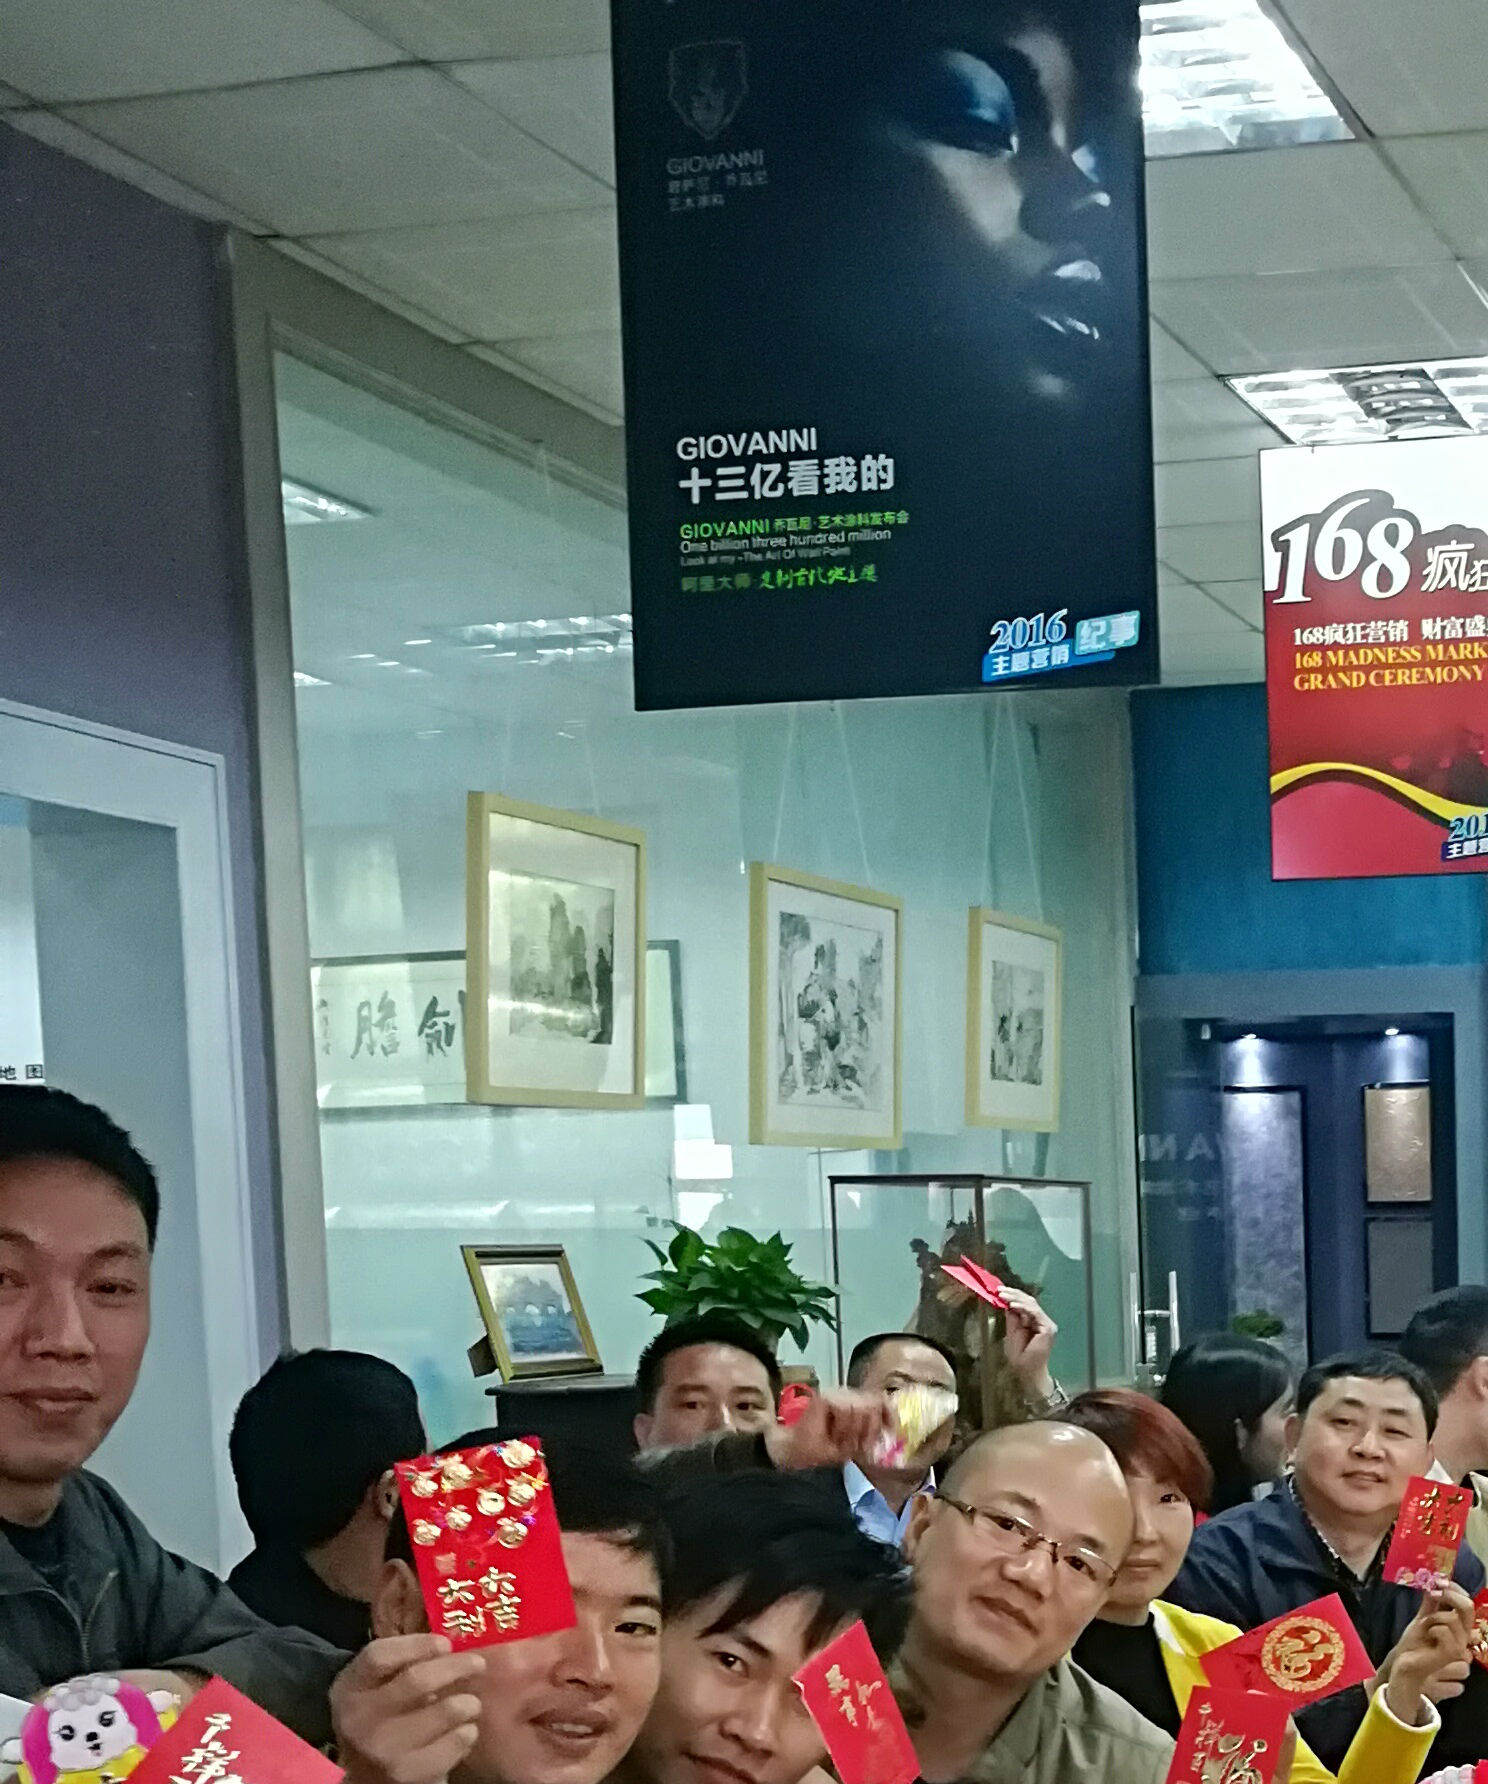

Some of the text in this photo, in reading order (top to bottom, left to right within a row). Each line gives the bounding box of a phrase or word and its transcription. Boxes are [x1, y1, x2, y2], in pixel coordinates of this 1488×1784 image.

[666, 149, 764, 174] GIOVANNI
[676, 427, 818, 460] GIOVANNI
[678, 453, 895, 504] 十三亿看我的
[680, 519, 770, 539] GIOVANNI
[751, 536, 787, 548] three
[789, 530, 845, 545] hundred
[1272, 498, 1414, 603] 168
[989, 608, 1068, 654] 2016
[1294, 620, 1409, 646] 168疯狂营销
[1294, 651, 1323, 669] 168
[1326, 646, 1421, 668] MADNESS
[1294, 664, 1486, 691] GRAND CEREMONY
